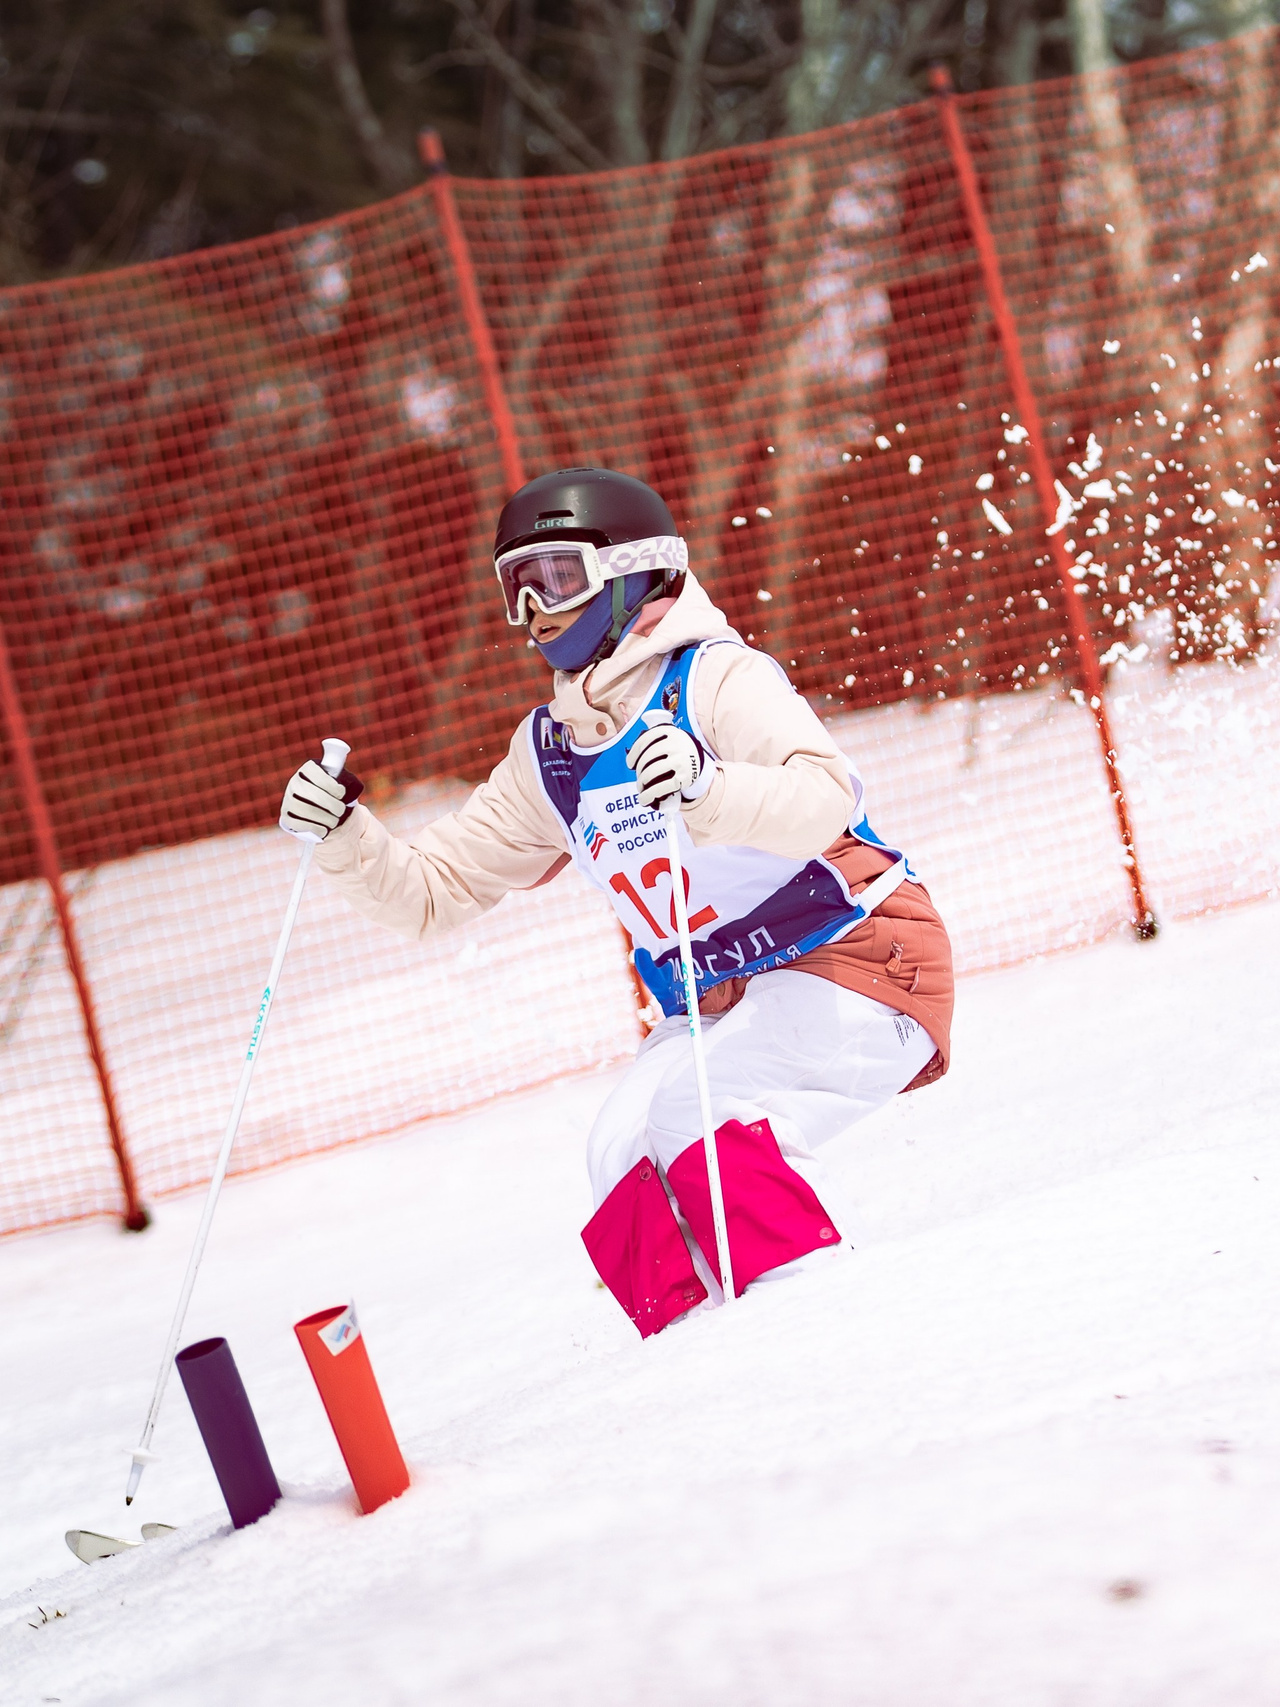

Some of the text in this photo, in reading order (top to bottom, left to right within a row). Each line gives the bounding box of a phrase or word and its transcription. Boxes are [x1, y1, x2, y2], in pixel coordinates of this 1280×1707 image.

[605, 793, 640, 814] ФЕДЕ
[611, 810, 665, 834] ФРИСТА
[617, 828, 668, 853] РОССИ
[609, 857, 719, 939] 12
